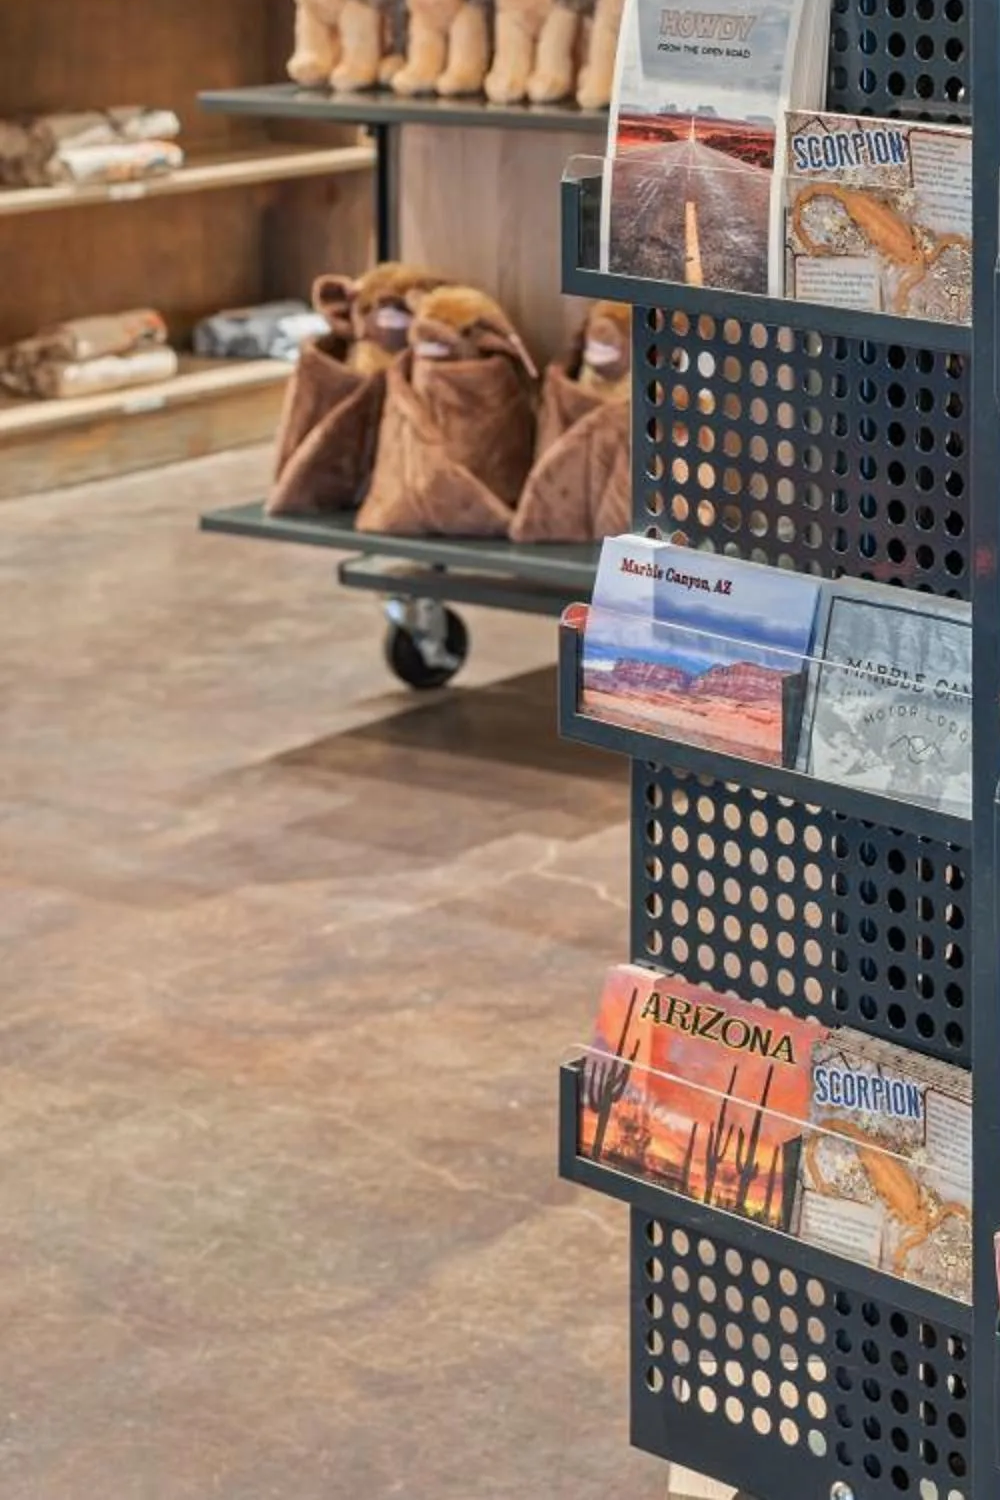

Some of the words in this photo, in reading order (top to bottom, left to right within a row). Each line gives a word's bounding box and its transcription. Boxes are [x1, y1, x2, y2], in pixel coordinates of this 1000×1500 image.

[659, 9, 757, 41] HOWDY
[793, 131, 907, 169] SCORPION
[621, 557, 664, 580] Marble
[713, 579, 733, 596] AZ
[844, 657, 926, 692] MARBLE
[864, 705, 919, 724] MOTOR
[641, 991, 797, 1064] ARIZONA
[814, 1068, 921, 1119] SCORPION
